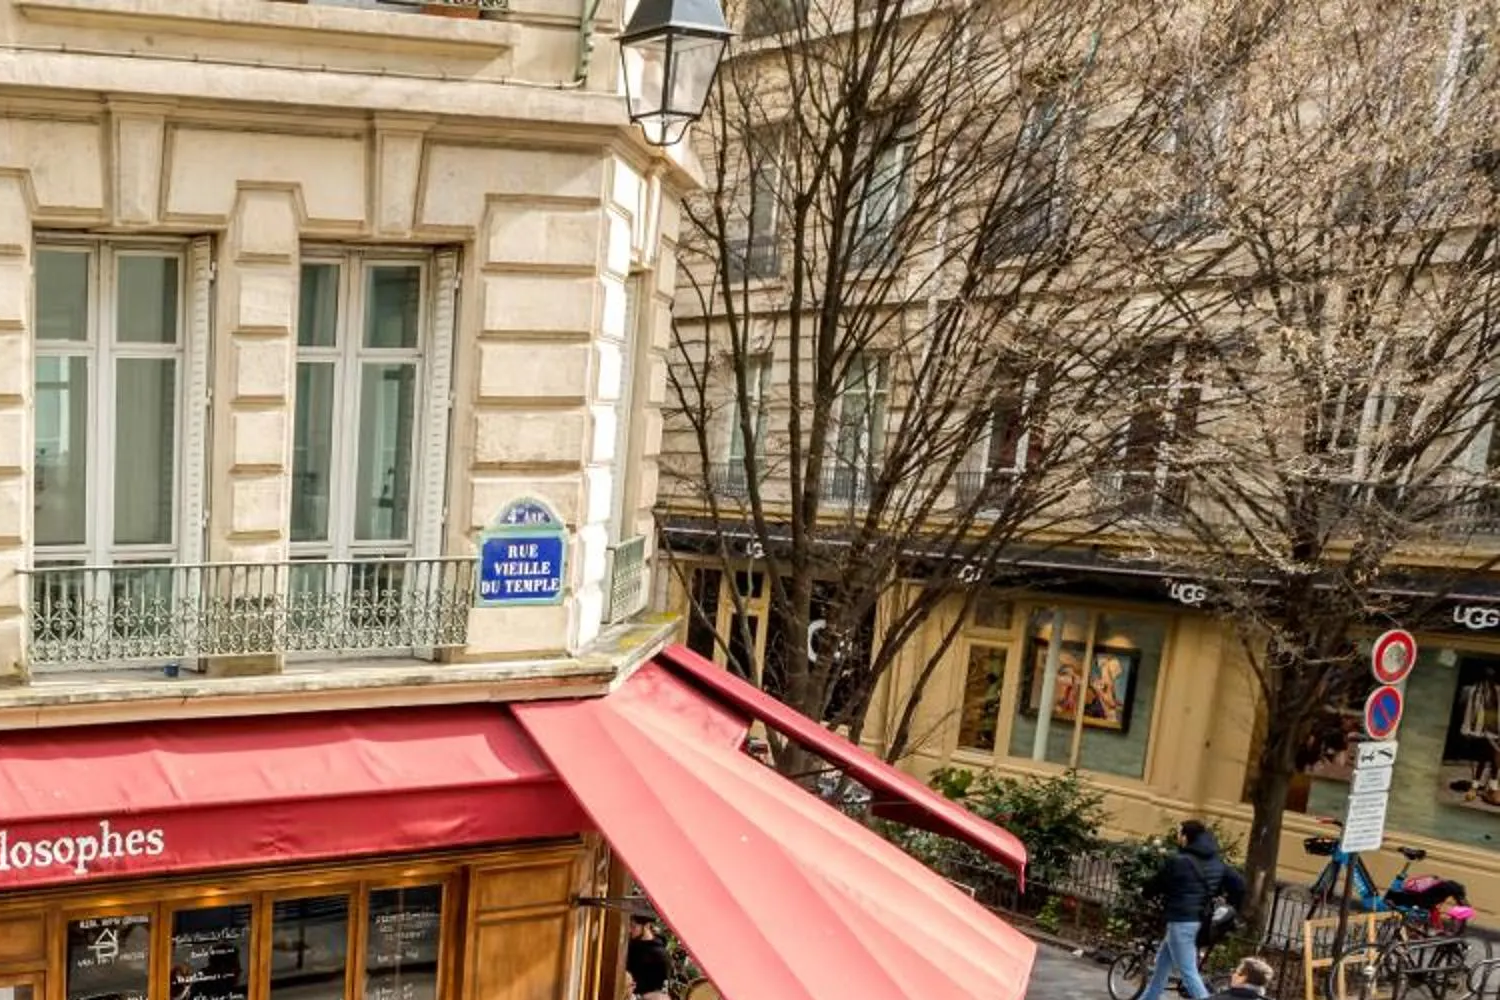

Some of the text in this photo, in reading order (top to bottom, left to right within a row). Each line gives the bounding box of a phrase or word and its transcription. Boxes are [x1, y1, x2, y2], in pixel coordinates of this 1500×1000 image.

[508, 543, 539, 559] RUE
[494, 561, 551, 576] VIEILLE
[481, 577, 560, 594] DU TEMPLE
[1171, 583, 1207, 603] UGG
[1453, 605, 1500, 629] UGG
